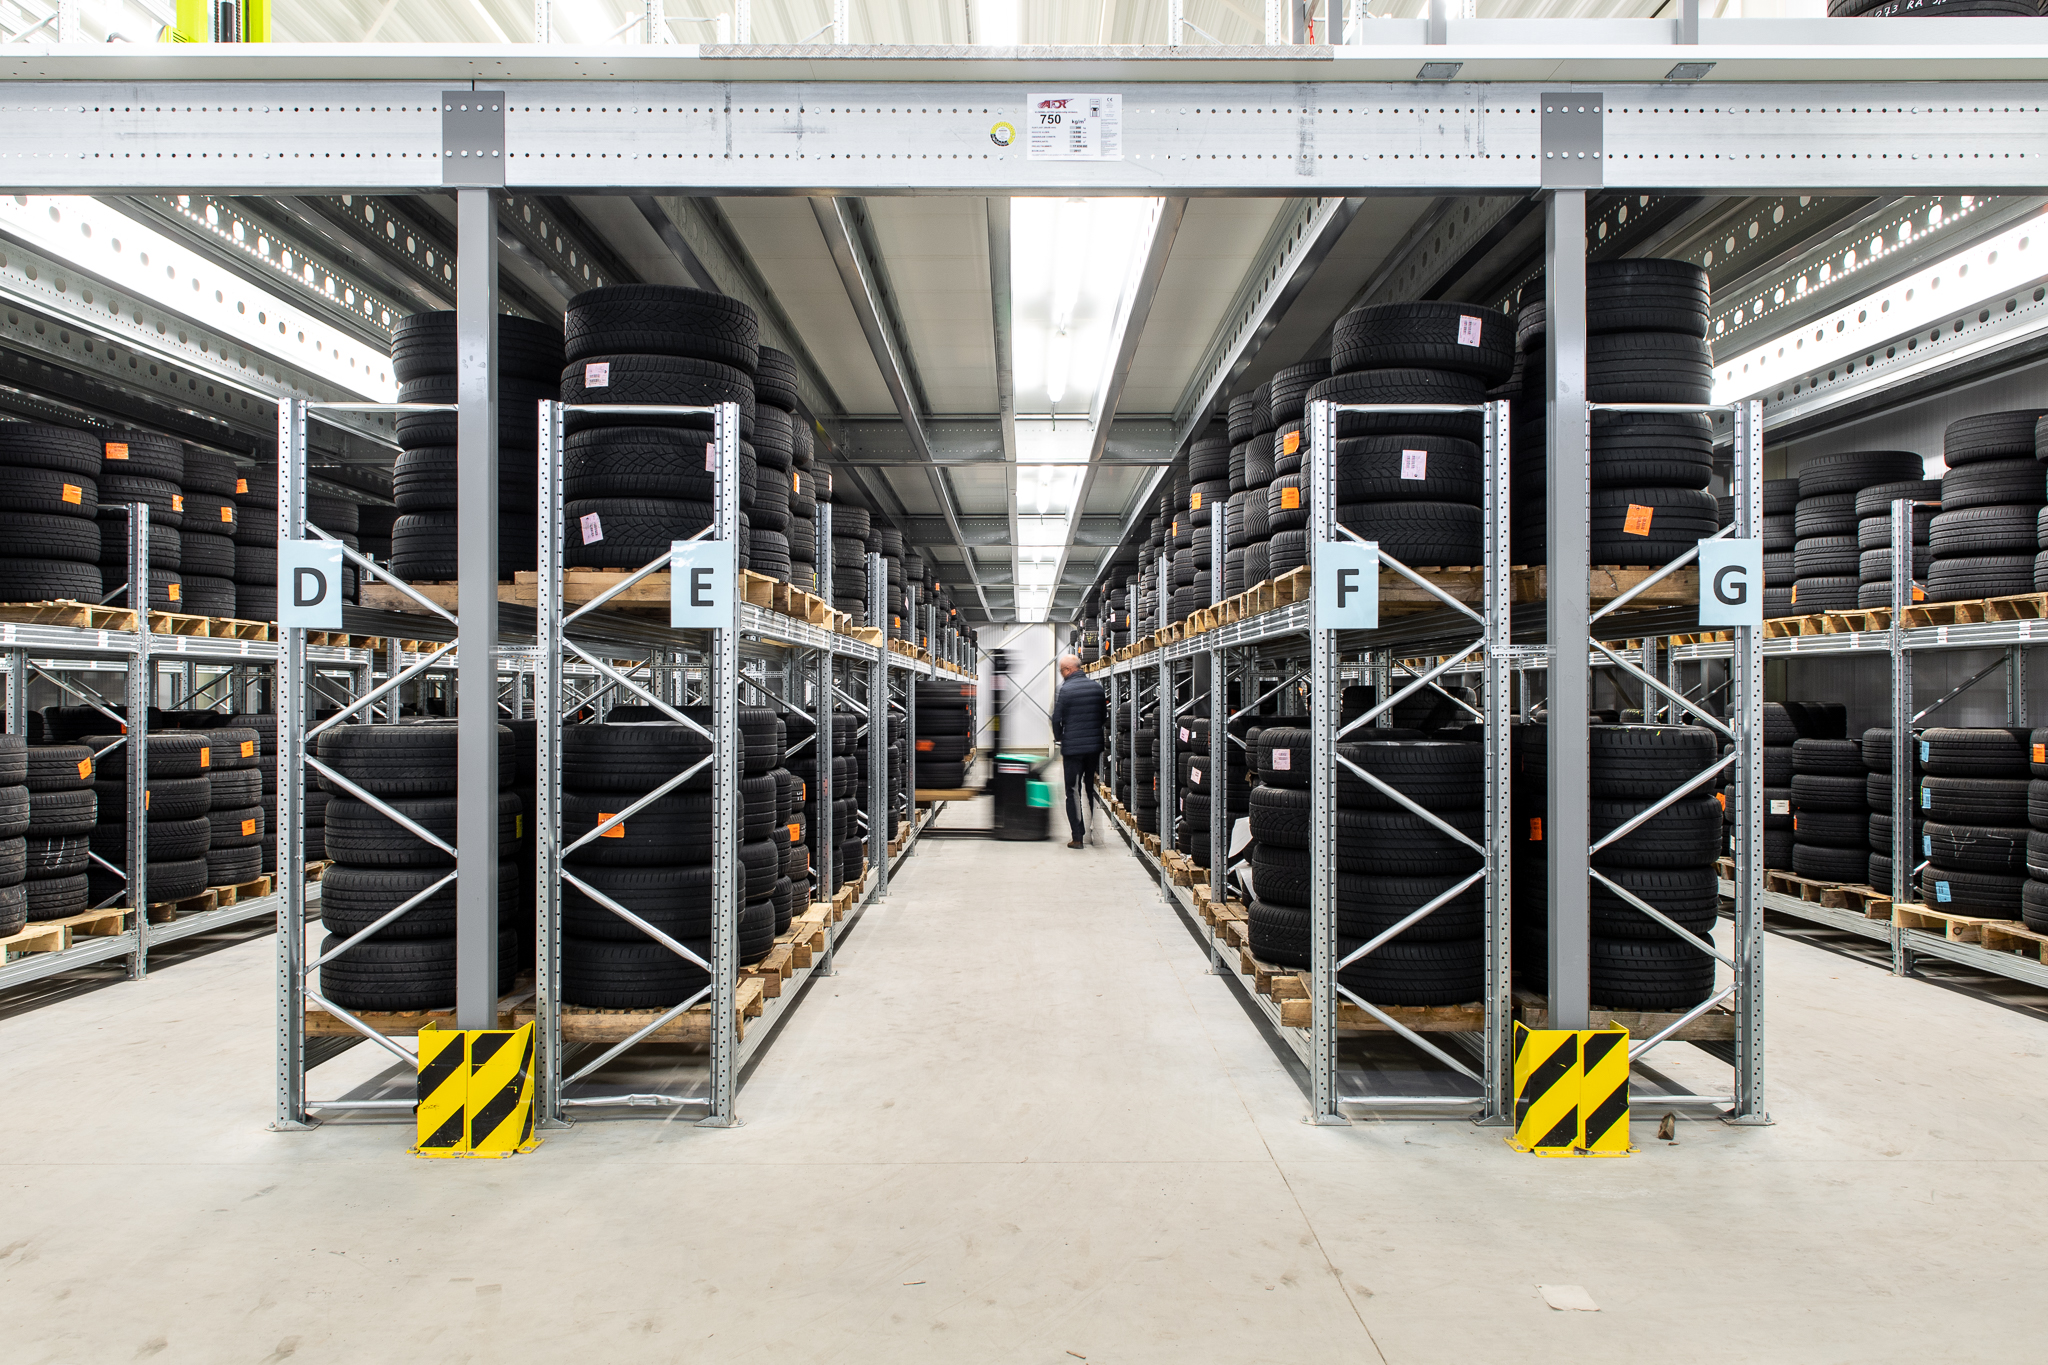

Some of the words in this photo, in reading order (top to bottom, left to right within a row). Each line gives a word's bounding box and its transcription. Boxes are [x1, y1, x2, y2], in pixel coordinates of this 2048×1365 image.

[1875, 5, 1899, 17] 273
[1907, 0, 1923, 9] RA
[1040, 114, 1061, 125] 750
[293, 567, 327, 607] D
[690, 567, 714, 607] E
[1337, 568, 1360, 609] F
[1713, 564, 1747, 606] G
